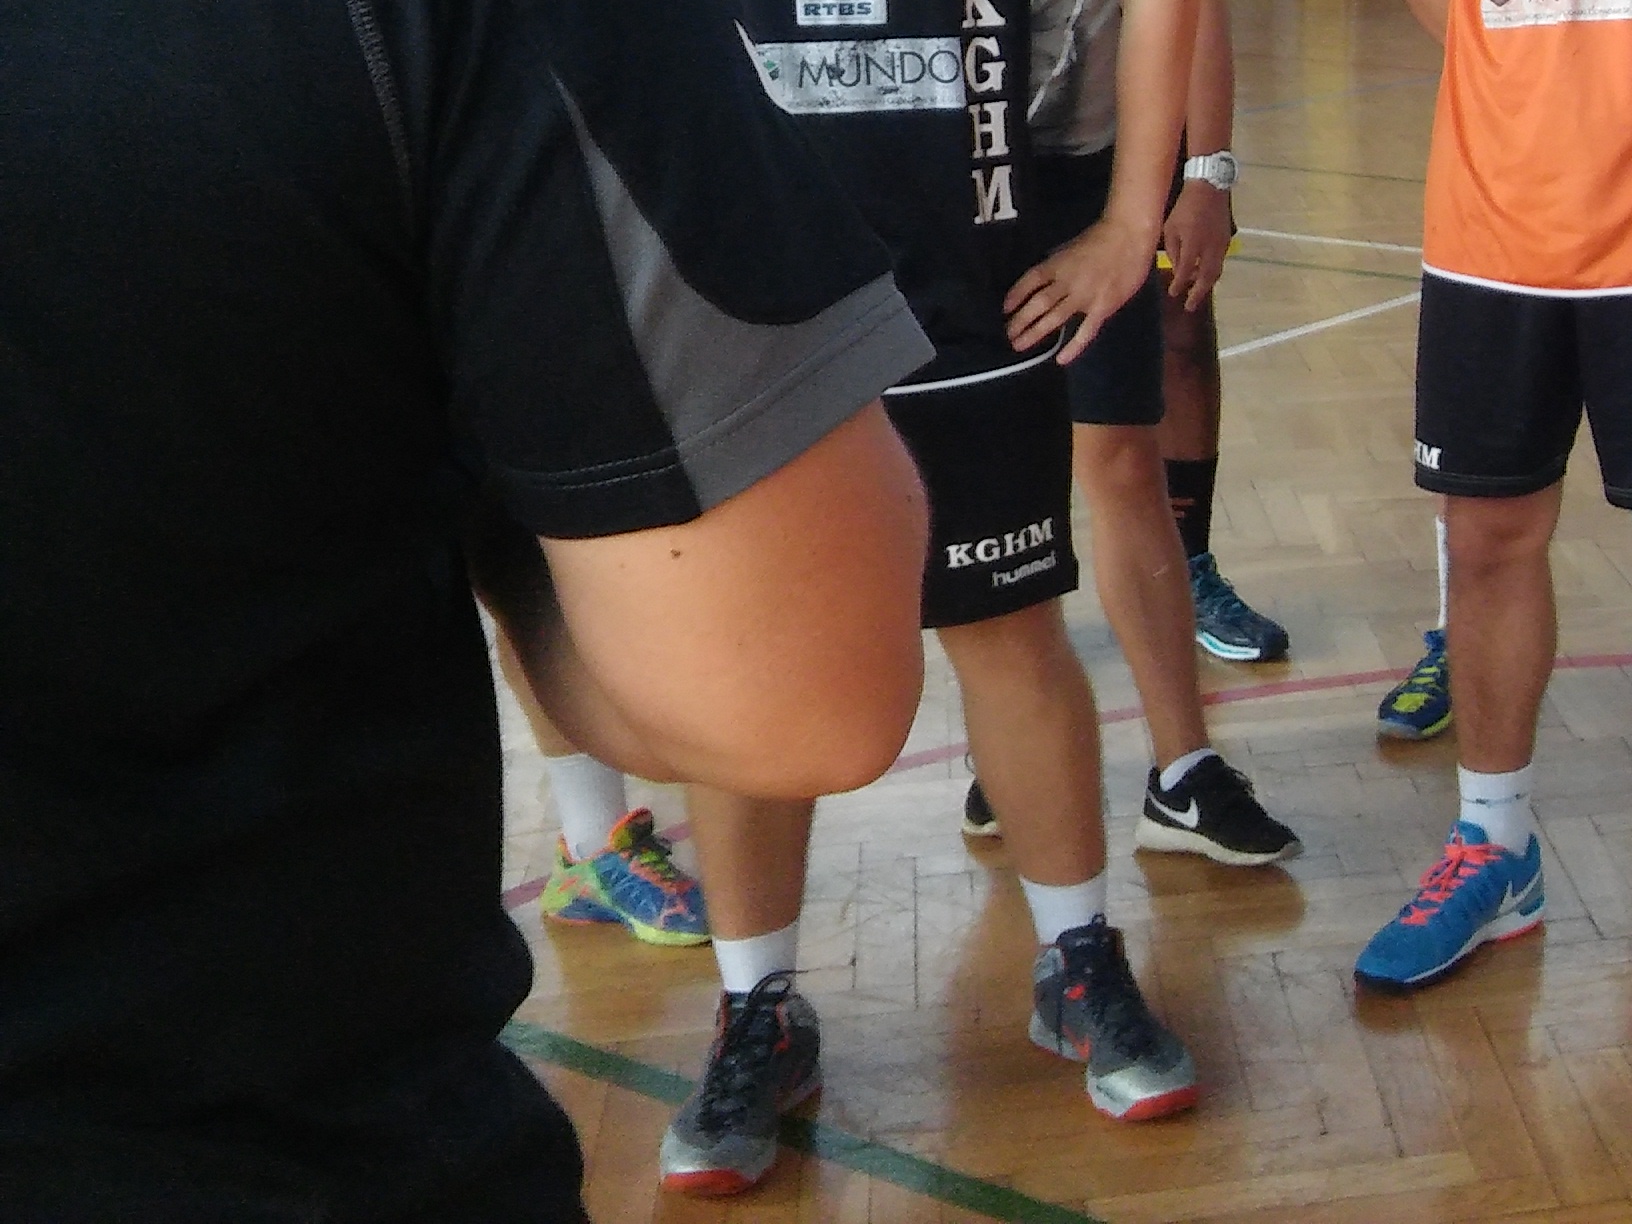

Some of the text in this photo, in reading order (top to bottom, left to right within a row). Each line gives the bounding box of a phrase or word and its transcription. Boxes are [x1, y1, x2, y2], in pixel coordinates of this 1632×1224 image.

[803, 1, 873, 17] RTBS
[798, 49, 961, 90] MUNDO
[945, 516, 1055, 569] KGHM
